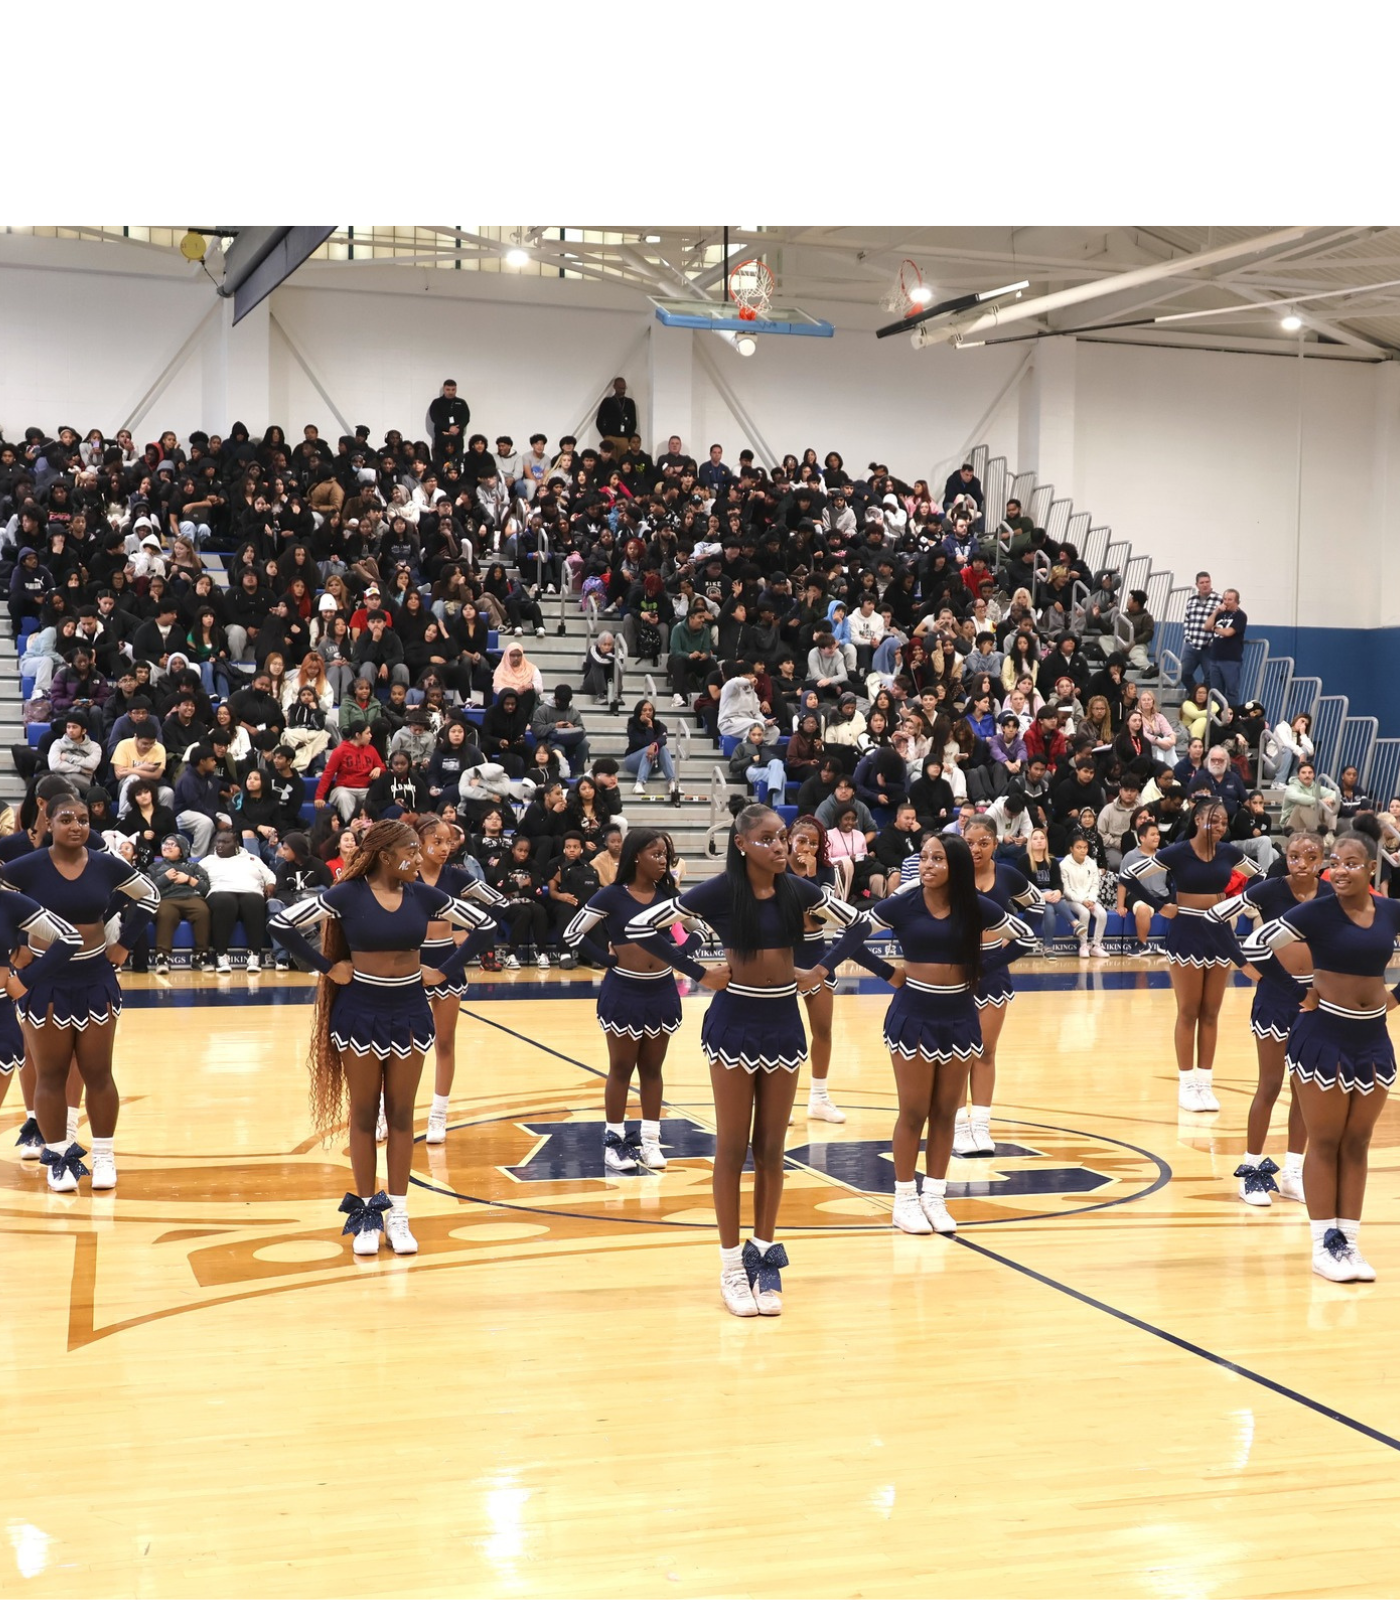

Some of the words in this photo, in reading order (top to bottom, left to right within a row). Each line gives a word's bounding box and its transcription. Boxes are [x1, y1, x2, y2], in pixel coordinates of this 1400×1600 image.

[346, 754, 373, 767] GAP
[398, 860, 411, 871] AC
[1051, 943, 1077, 951] IKINGS
[694, 949, 726, 958] VIKING
